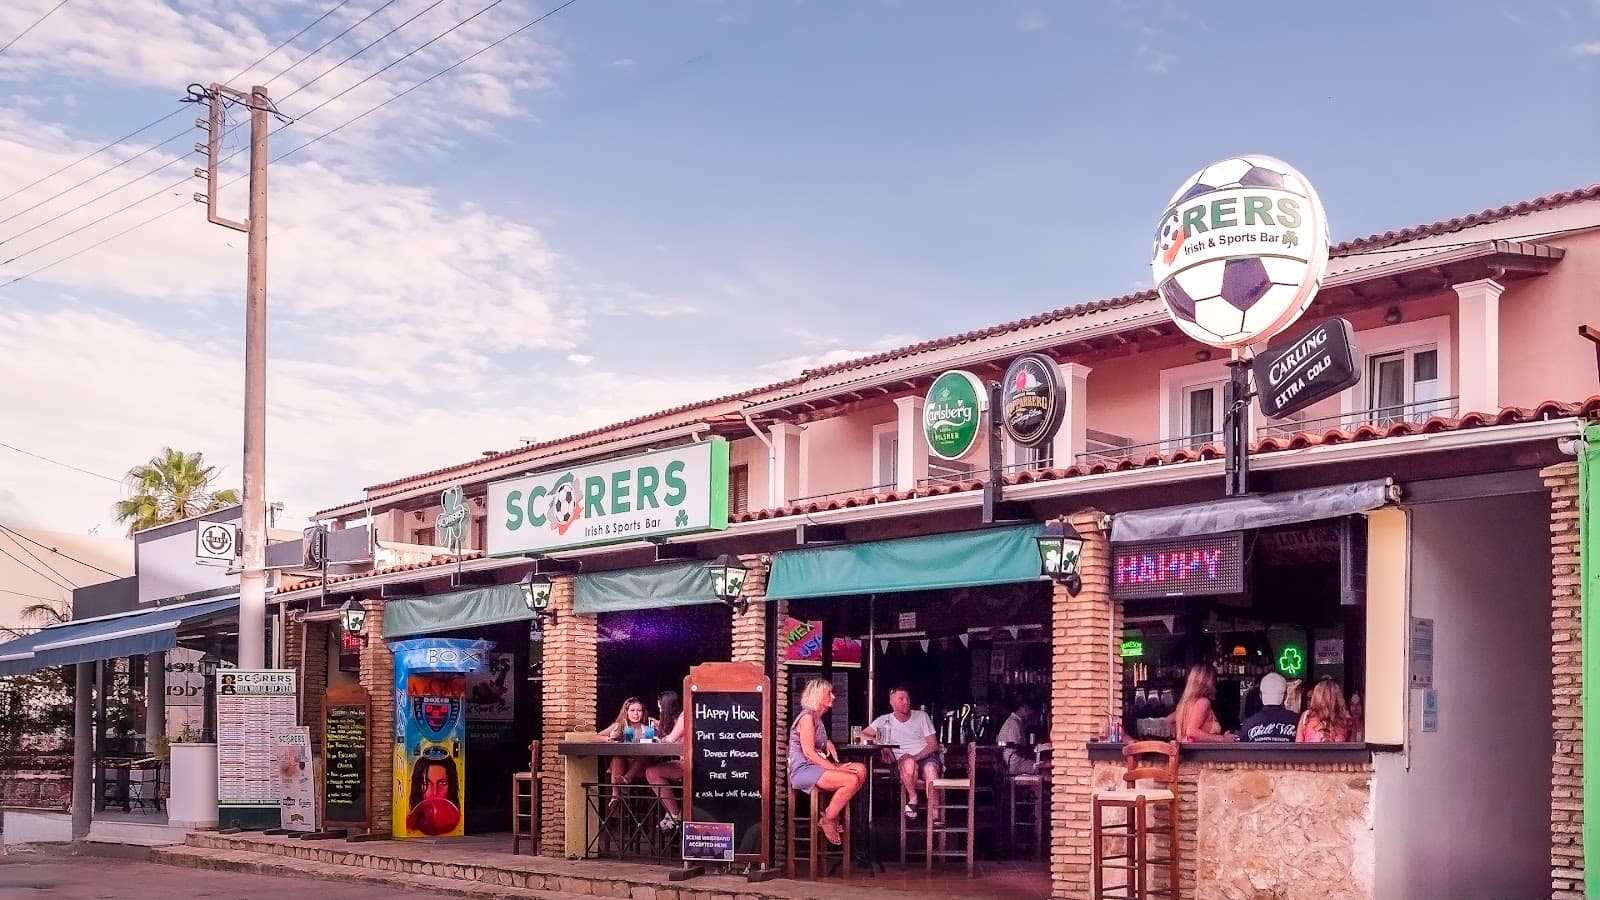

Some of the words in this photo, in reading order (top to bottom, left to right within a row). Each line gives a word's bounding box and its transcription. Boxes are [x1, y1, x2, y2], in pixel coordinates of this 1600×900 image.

[1184, 241, 1205, 255] Irish
[1208, 238, 1216, 247] &
[1219, 232, 1256, 246] Sports
[1260, 232, 1279, 243] Bar
[1269, 328, 1327, 386] CARLING
[1275, 377, 1305, 409] EXTRA
[1307, 355, 1332, 380] COLD
[927, 402, 973, 425] Carlsberg
[506, 460, 687, 532] SCORERS
[585, 526, 604, 537] Irish
[605, 524, 611, 535] &
[612, 520, 641, 535] Sports
[645, 518, 661, 529] Bar
[1117, 550, 1220, 585] HAPPY
[787, 620, 814, 646] MEX
[695, 703, 729, 721] HAPPY
[732, 705, 759, 721] HOUR
[696, 730, 715, 741] PINT
[719, 732, 735, 740] SIZE
[1248, 723, 1276, 739] Chill
[709, 771, 727, 780] FREE
[731, 770, 749, 780] SHOT
[720, 760, 727, 768] &
